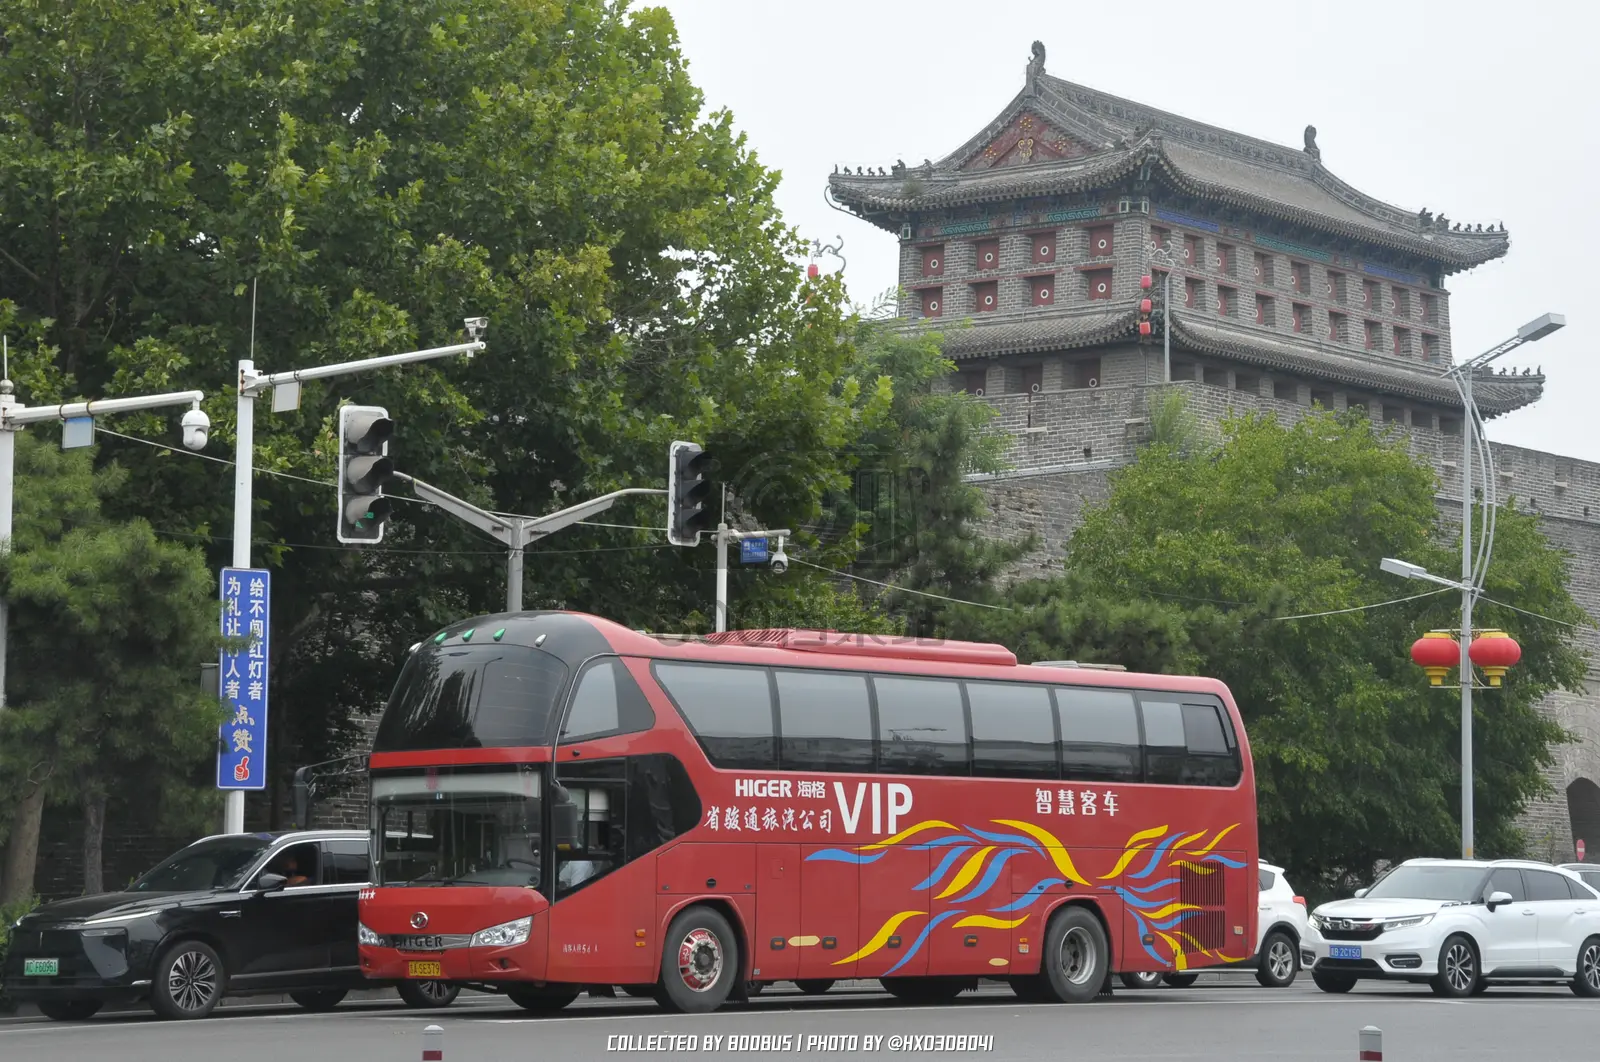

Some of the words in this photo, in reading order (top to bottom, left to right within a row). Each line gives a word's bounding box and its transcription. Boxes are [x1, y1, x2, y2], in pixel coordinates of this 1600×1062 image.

[248, 577, 265, 701] 给不闯红灯者
[231, 704, 255, 753] 点赞
[735, 778, 792, 798] HIGER
[797, 780, 826, 799] 海格
[833, 781, 913, 835] VIP
[1035, 787, 1120, 817] 智慧客车
[703, 805, 832, 833] 省骏通旅汽公司
